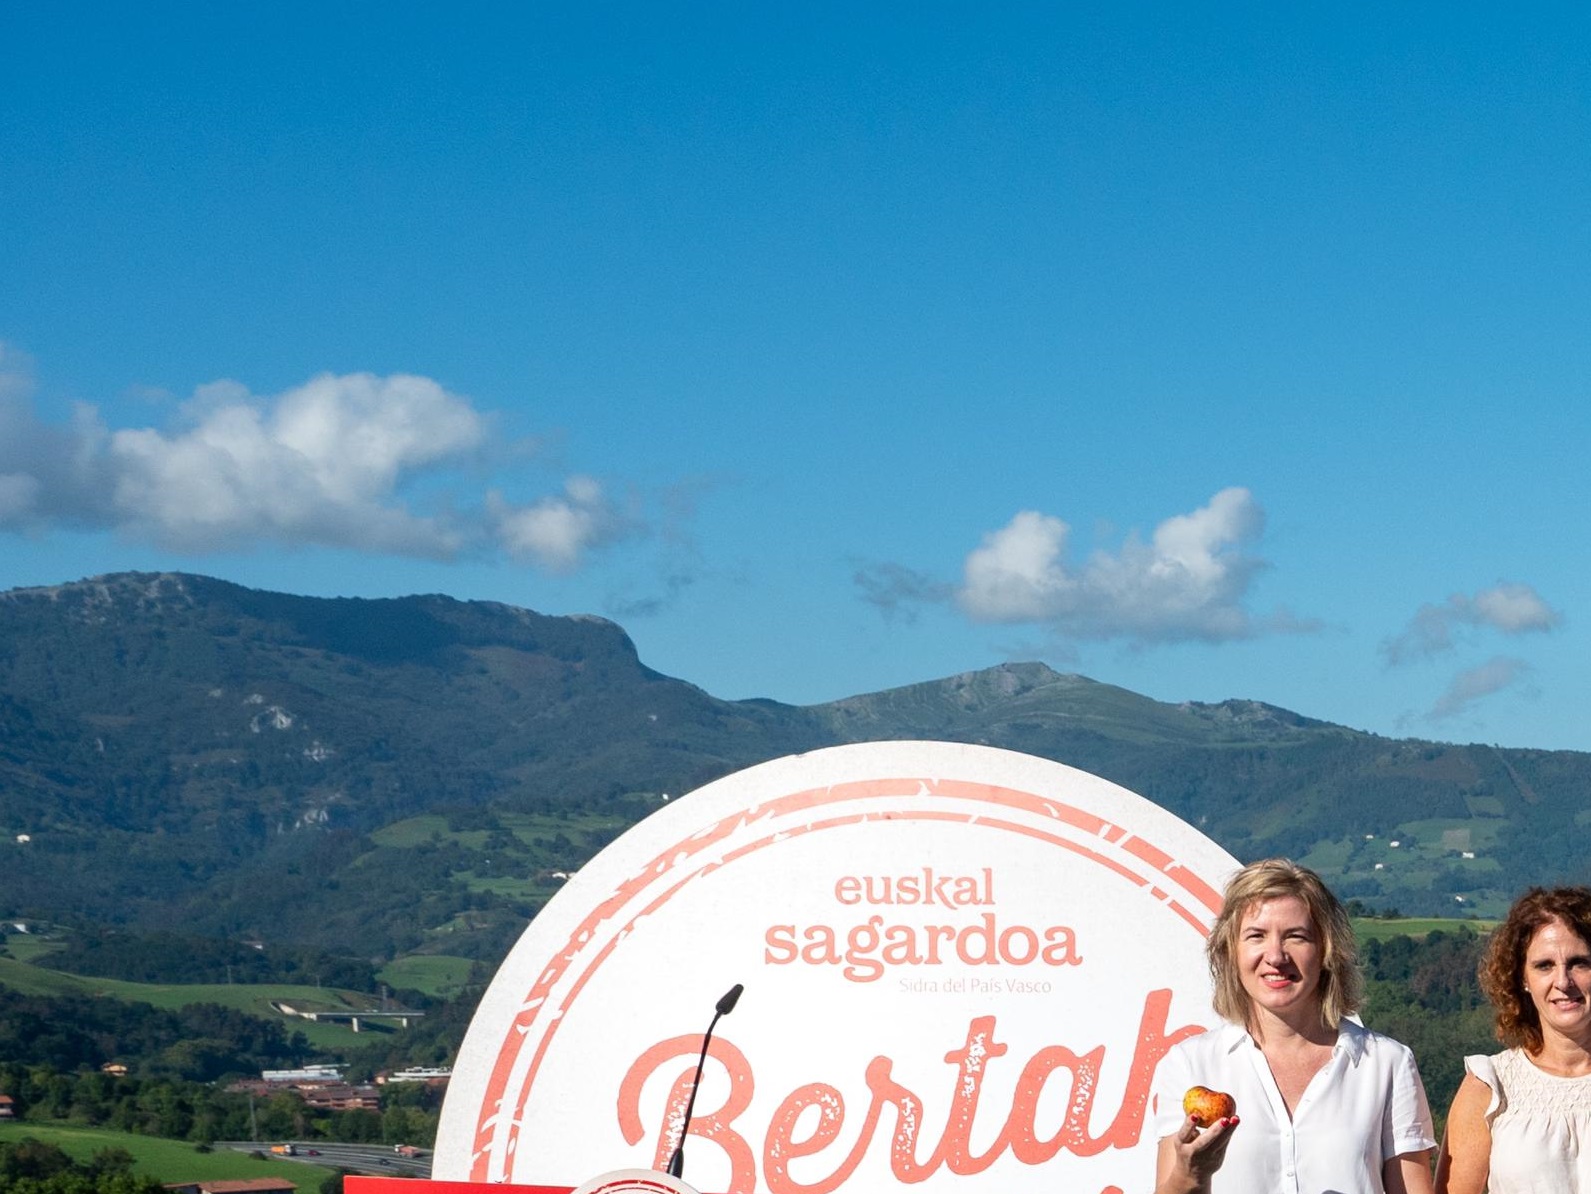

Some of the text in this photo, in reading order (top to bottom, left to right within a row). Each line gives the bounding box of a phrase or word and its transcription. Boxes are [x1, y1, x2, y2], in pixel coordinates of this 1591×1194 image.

[835, 867, 996, 910] euskal
[764, 912, 1084, 983] sagardoa
[899, 977, 1052, 994] Sidra del País Vasco
